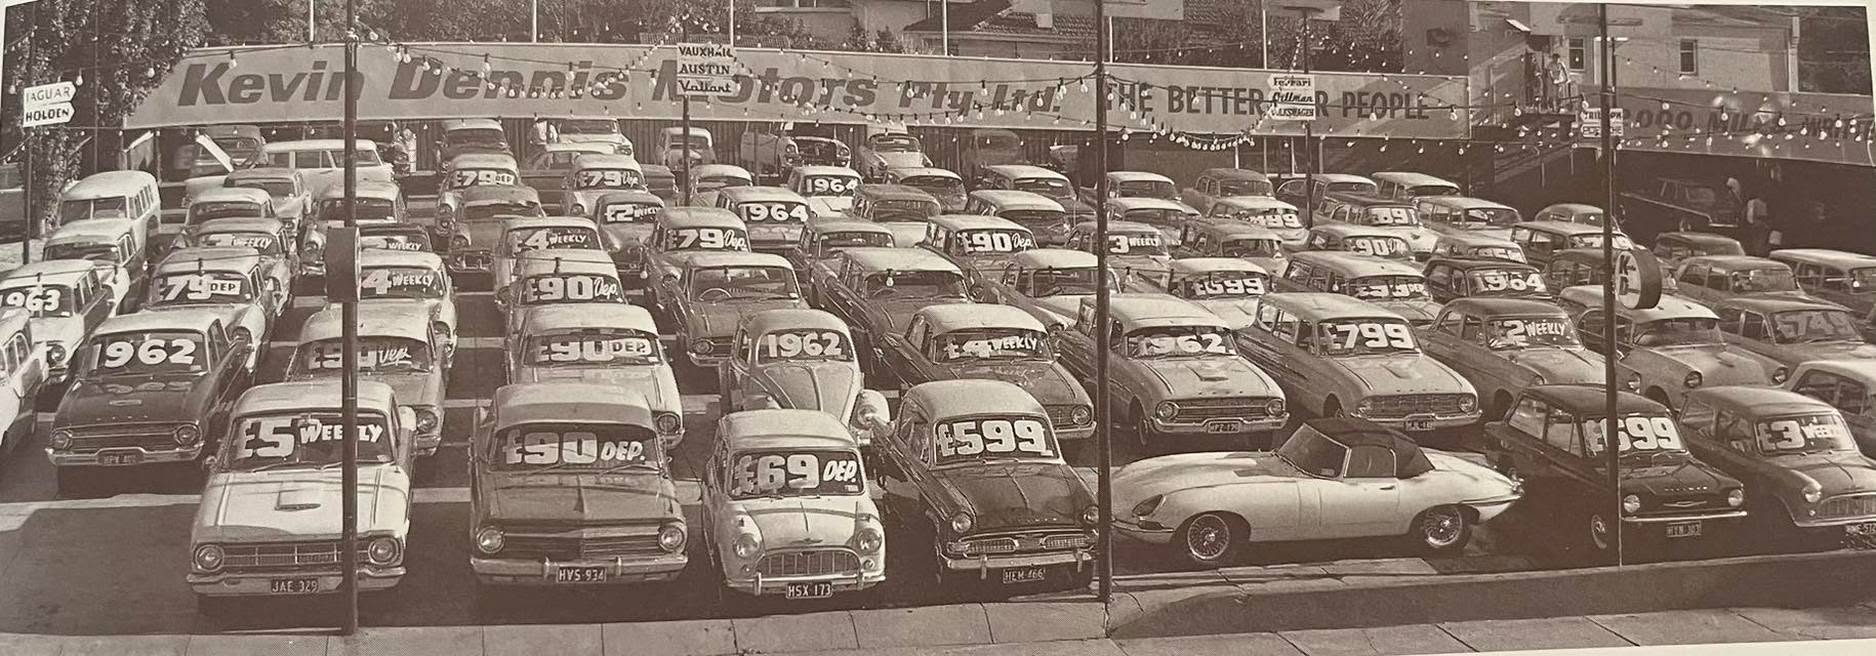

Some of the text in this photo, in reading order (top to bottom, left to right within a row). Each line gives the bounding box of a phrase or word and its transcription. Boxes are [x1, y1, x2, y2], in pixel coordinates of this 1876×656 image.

[178, 60, 364, 106] Kevin
[388, 56, 631, 100] Dennis
[679, 63, 730, 75] AUSTIN
[678, 79, 732, 93] Valiant
[25, 108, 69, 122] HOLDEN
[1167, 85, 1264, 117] BETTER
[1342, 90, 1429, 120] PEOPLE
[807, 178, 857, 193] 1964
[739, 203, 809, 222] 1964
[549, 234, 587, 245] WEEKLY
[955, 232, 1012, 253] £90
[391, 272, 434, 287] WEEKLY
[524, 276, 594, 302] £90
[1474, 271, 1547, 294] 1964
[0, 285, 62, 312] 963
[1322, 322, 1415, 350] £799
[1525, 321, 1565, 337] WEEKLY
[94, 338, 196, 369] 1962
[767, 333, 843, 358] 1962
[237, 418, 383, 458] £5 WEELY
[936, 419, 1047, 457] £599
[1756, 419, 1806, 450] £3
[502, 430, 646, 465] £90 DEP.
[733, 453, 858, 496] £69 DEP.
[788, 583, 831, 597] HSX 173
